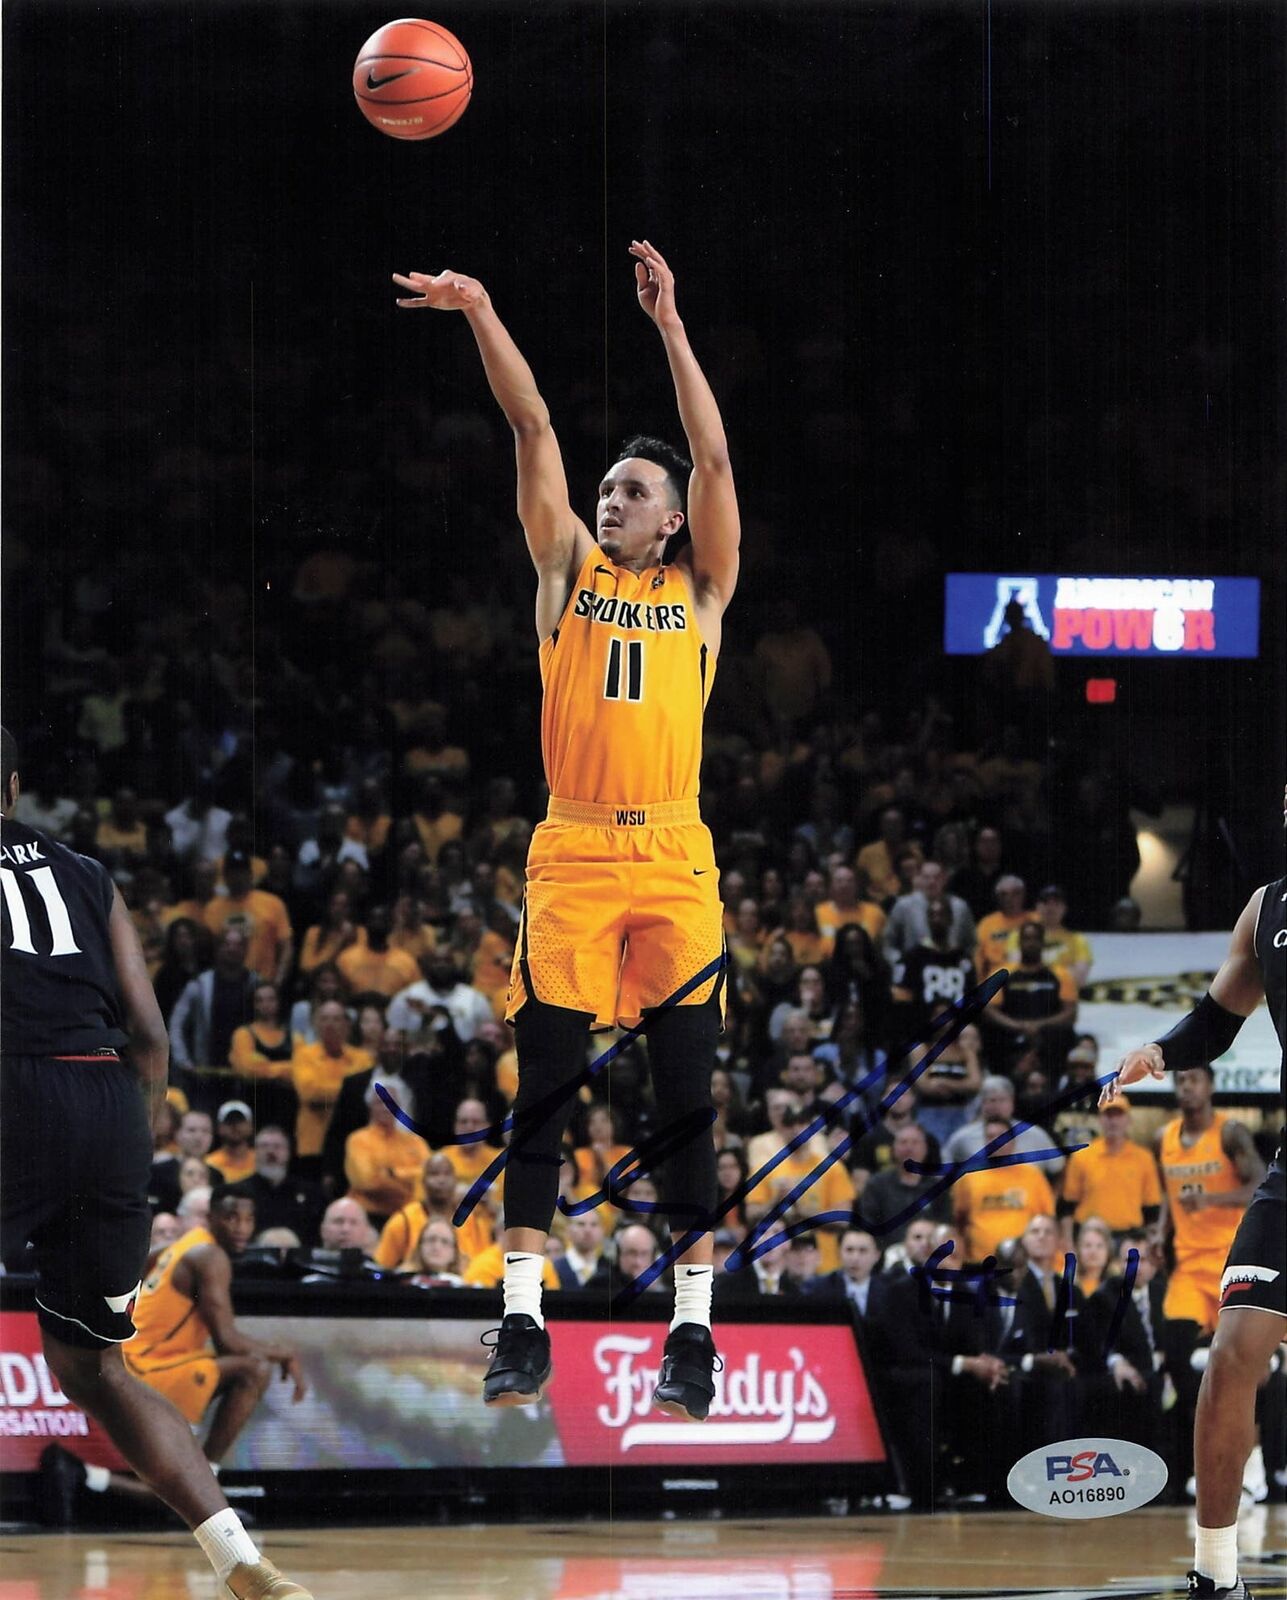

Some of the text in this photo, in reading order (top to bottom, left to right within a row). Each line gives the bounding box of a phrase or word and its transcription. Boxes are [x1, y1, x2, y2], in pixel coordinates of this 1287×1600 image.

[573, 588, 687, 632] SHOCKERS
[603, 637, 644, 703] 11
[616, 810, 646, 826] WSU
[1, 865, 83, 957] 11
[1045, 1450, 1124, 1482] PSA
[1049, 1486, 1126, 1505] AO16890
